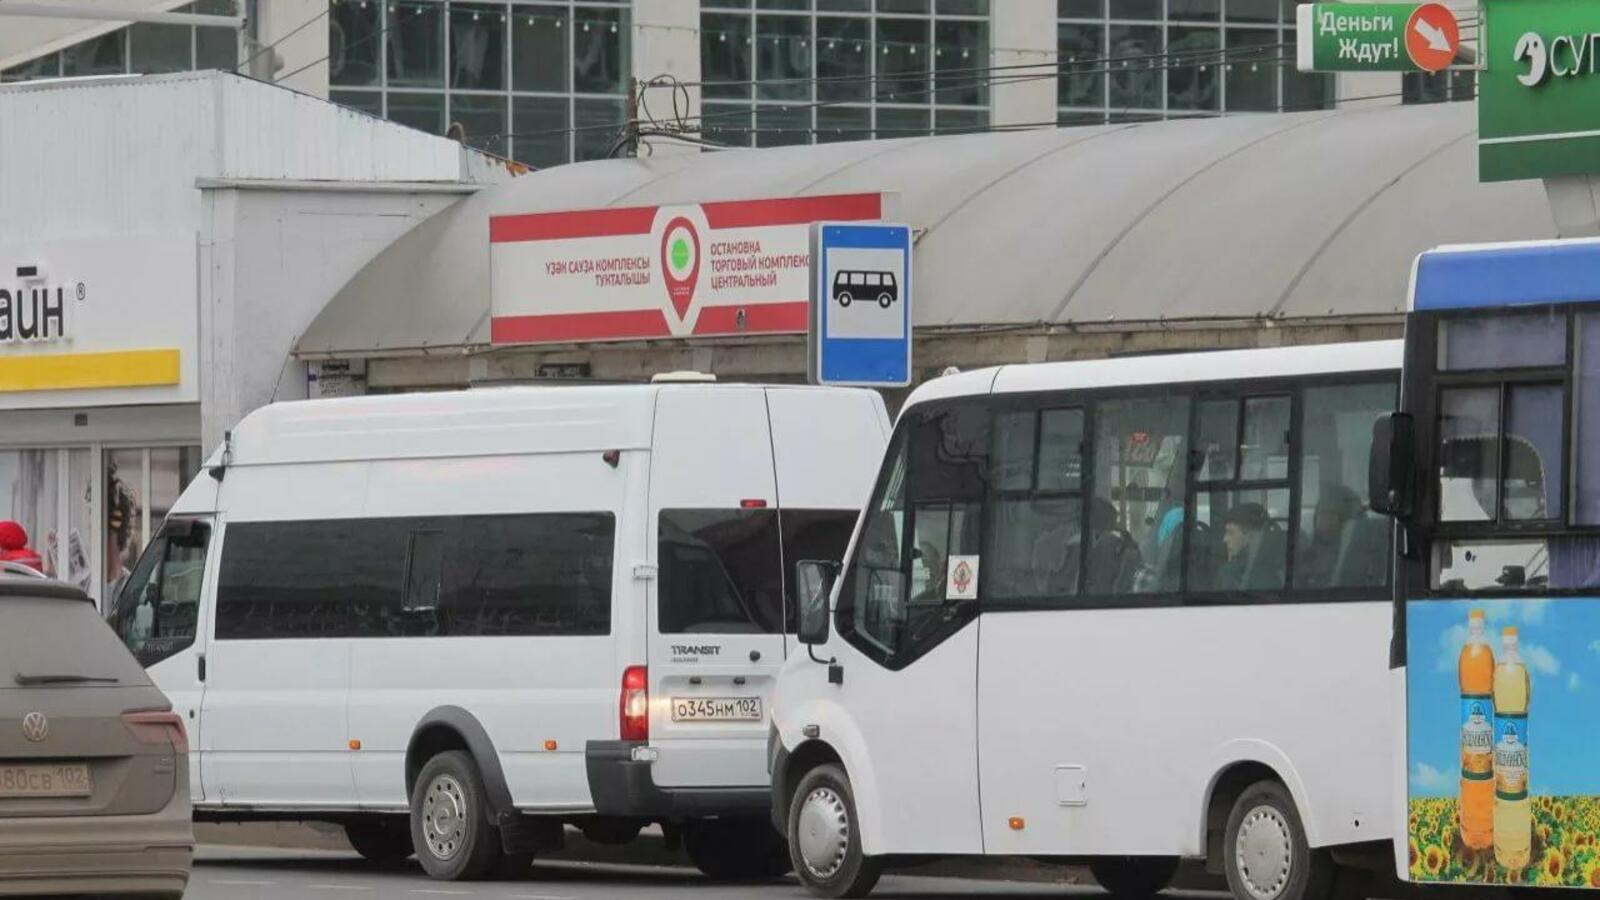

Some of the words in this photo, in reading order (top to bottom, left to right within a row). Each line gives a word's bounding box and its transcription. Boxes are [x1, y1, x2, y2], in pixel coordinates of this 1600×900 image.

[1320, 11, 1393, 36] Деньги
[1339, 37, 1398, 63] Ждут!
[710, 241, 761, 255] ОСТАНОВКА
[710, 255, 757, 272] ТОРГОВЫЙ
[710, 270, 777, 291] ЦЕНТРАЛЬНЫЙ
[671, 645, 721, 655] TRANSIT
[736, 699, 756, 712] 102
